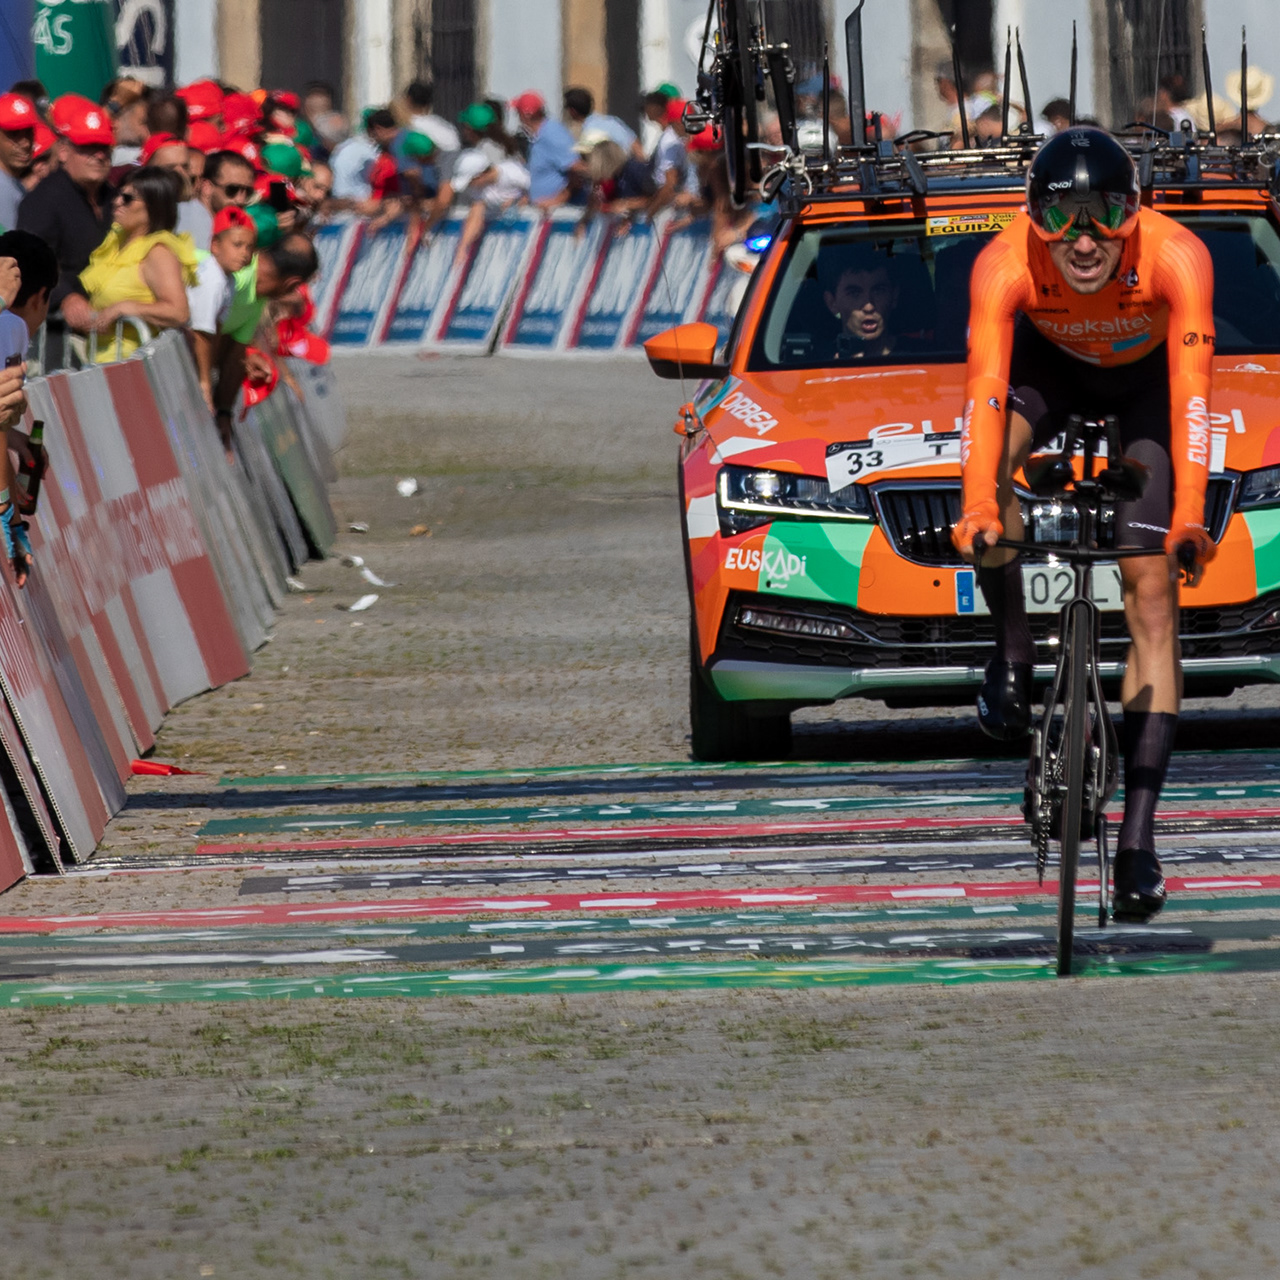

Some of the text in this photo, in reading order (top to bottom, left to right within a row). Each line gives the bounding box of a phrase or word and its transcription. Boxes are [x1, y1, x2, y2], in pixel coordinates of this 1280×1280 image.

[32, 6, 74, 55] ÁS
[930, 223, 1004, 234] EQUIPA
[1037, 313, 1153, 337] euskaltel
[719, 391, 779, 436] ORBEA
[846, 451, 884, 476] 33
[1030, 570, 1074, 605] 02
